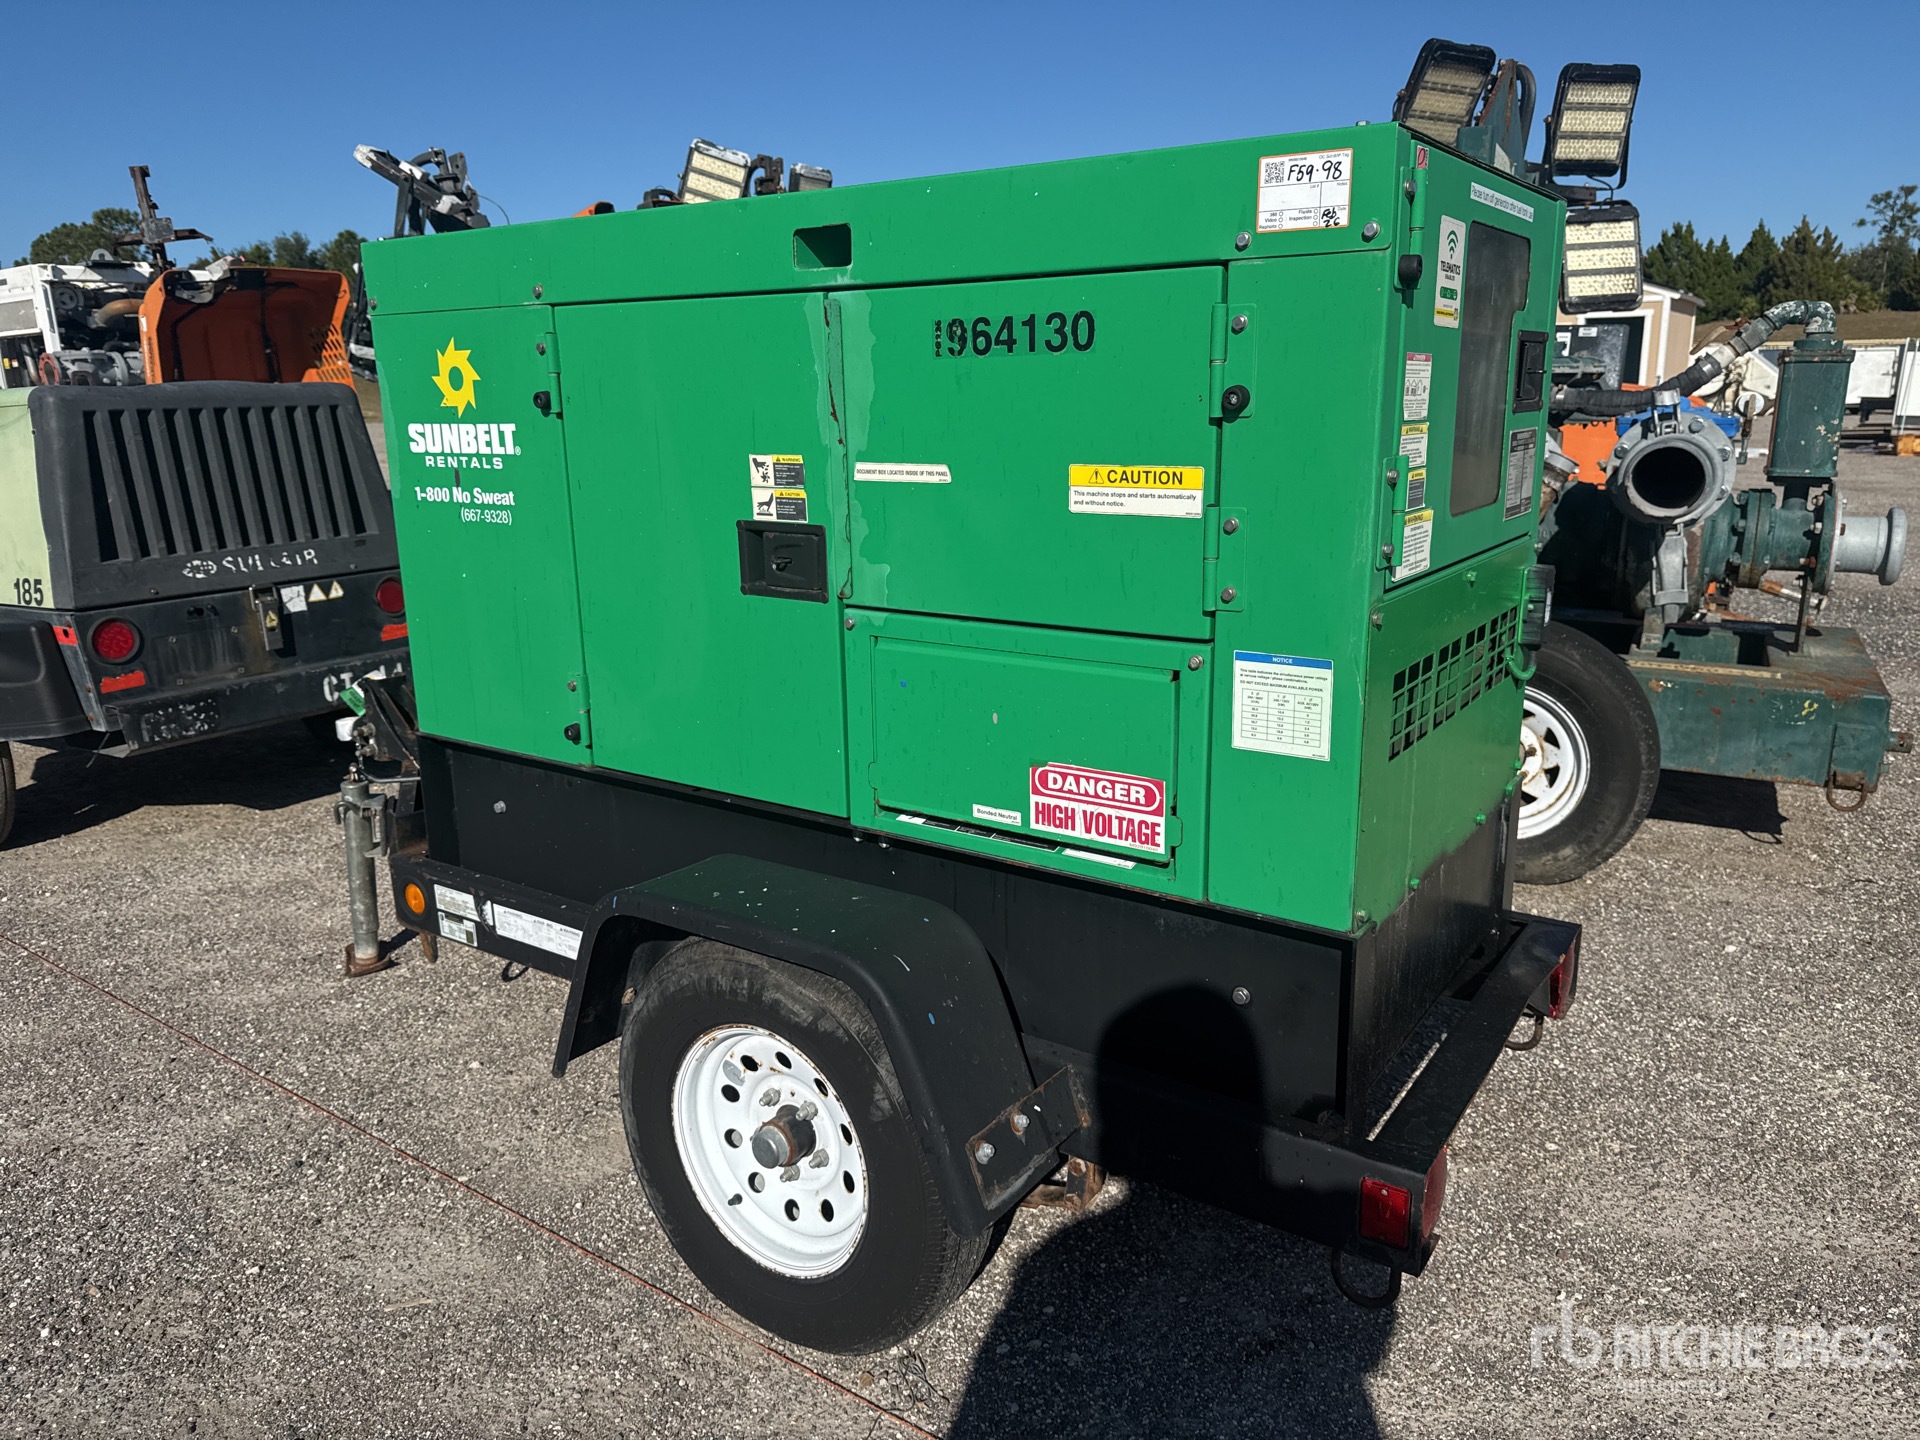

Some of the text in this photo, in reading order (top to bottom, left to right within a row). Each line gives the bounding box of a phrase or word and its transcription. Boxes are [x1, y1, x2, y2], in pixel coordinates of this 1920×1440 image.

[1441, 260, 1460, 275] TELEMATICS
[946, 310, 1095, 357] 964130
[425, 456, 503, 469] RENTALS
[1107, 469, 1182, 485] CAUTION
[415, 486, 515, 505] 1-800 No Sweat
[1086, 490, 1109, 498] machine
[1158, 493, 1196, 501] automatically
[461, 506, 512, 525] (667-9328)
[14, 577, 44, 606] 185
[1047, 772, 1146, 804] DANGER
[977, 808, 1017, 820] Bonded Neutral
[1034, 801, 1076, 831] HIGH
[1082, 809, 1161, 848] VOLTAGE
